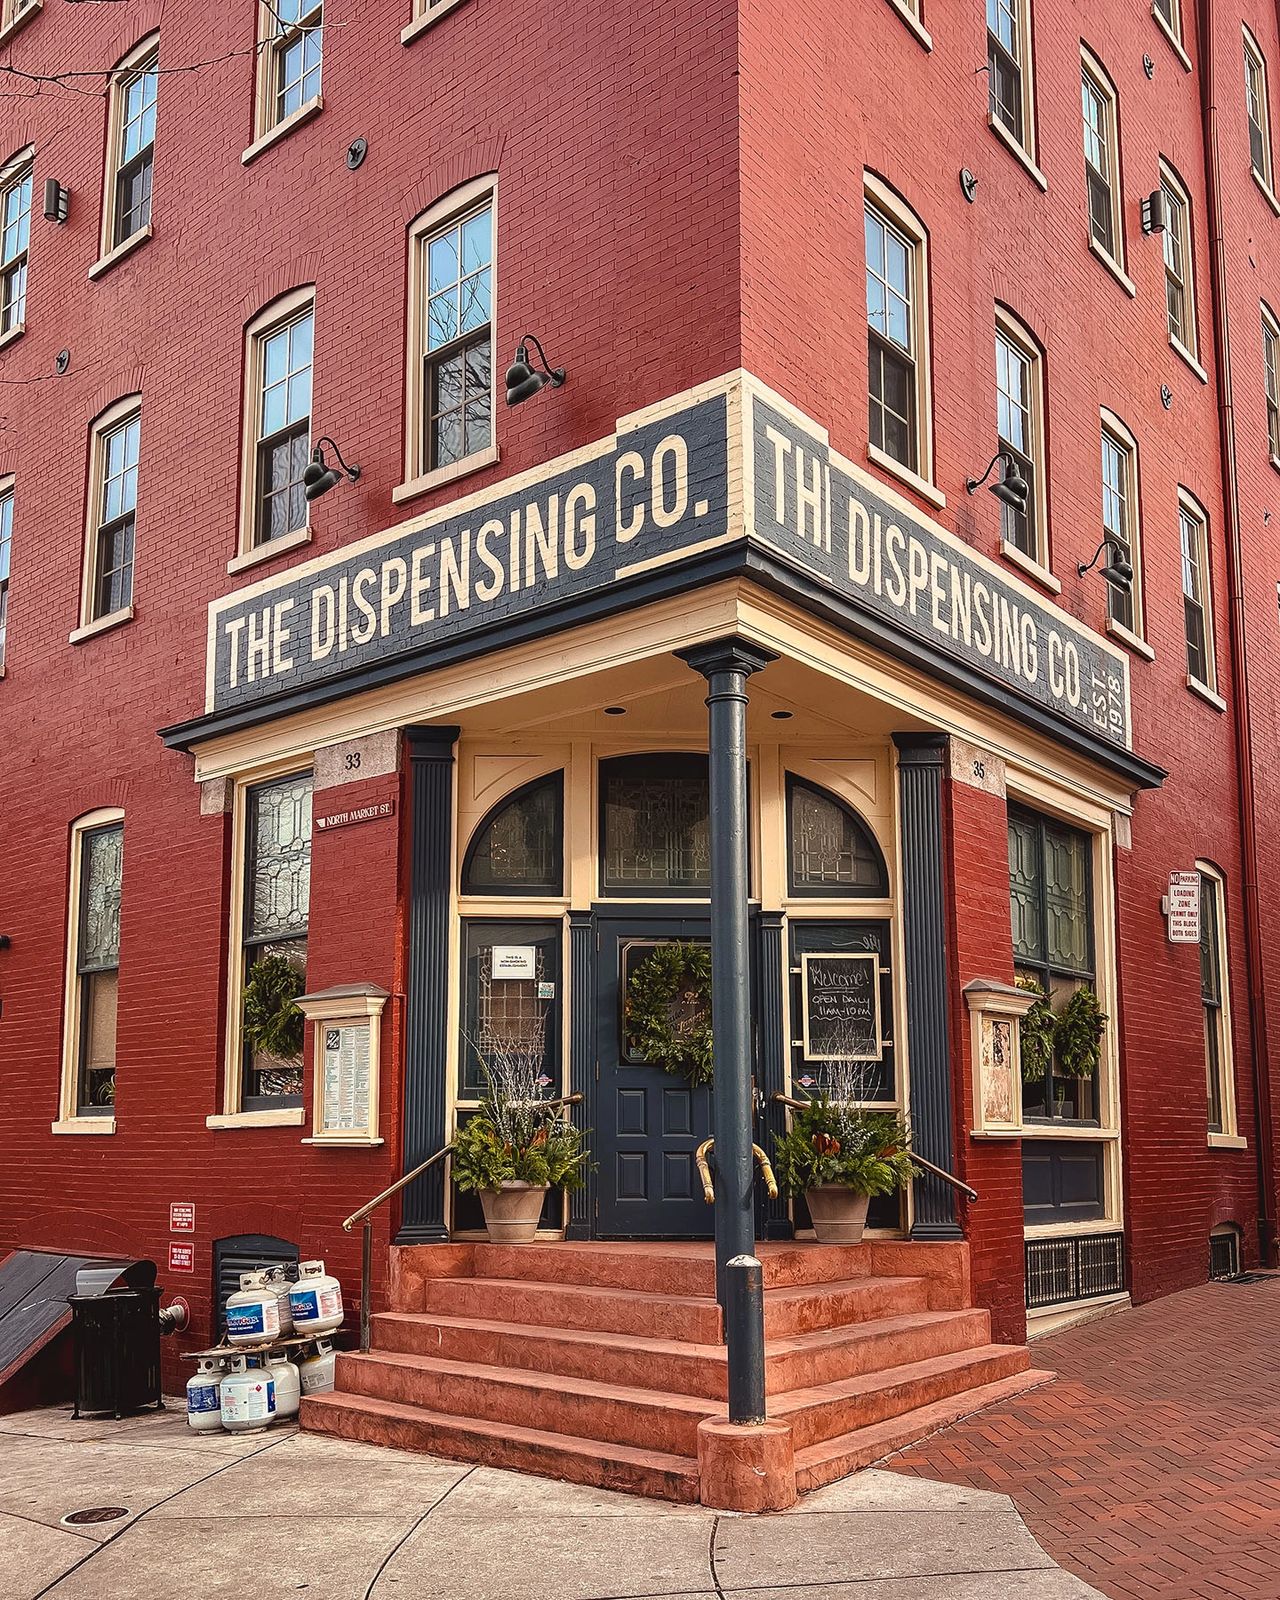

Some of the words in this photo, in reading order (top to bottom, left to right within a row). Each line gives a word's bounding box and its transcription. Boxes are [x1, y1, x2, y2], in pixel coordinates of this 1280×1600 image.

[225, 599, 294, 690] THE
[311, 482, 597, 661] DISPENSING
[615, 433, 709, 544] CO.
[848, 496, 1039, 683] DISPENSING
[1048, 630, 1087, 714] CO.
[1091, 671, 1108, 729] EST.
[1108, 675, 1123, 735] 1978
[345, 752, 361, 770] 33
[973, 760, 985, 779] 35
[326, 812, 349, 827] NORTH
[349, 805, 379, 821] MARKET
[1171, 873, 1180, 885] NO
[1180, 875, 1198, 883] PARKING
[1173, 889, 1195, 898] LOADING
[1171, 910, 1187, 918] PERMIT
[1172, 929, 1183, 937] BOTH
[1183, 920, 1197, 928] BLOCK
[810, 966, 869, 987] Welcome!
[812, 995, 838, 1004] OPEN
[842, 995, 870, 1010] DAILY
